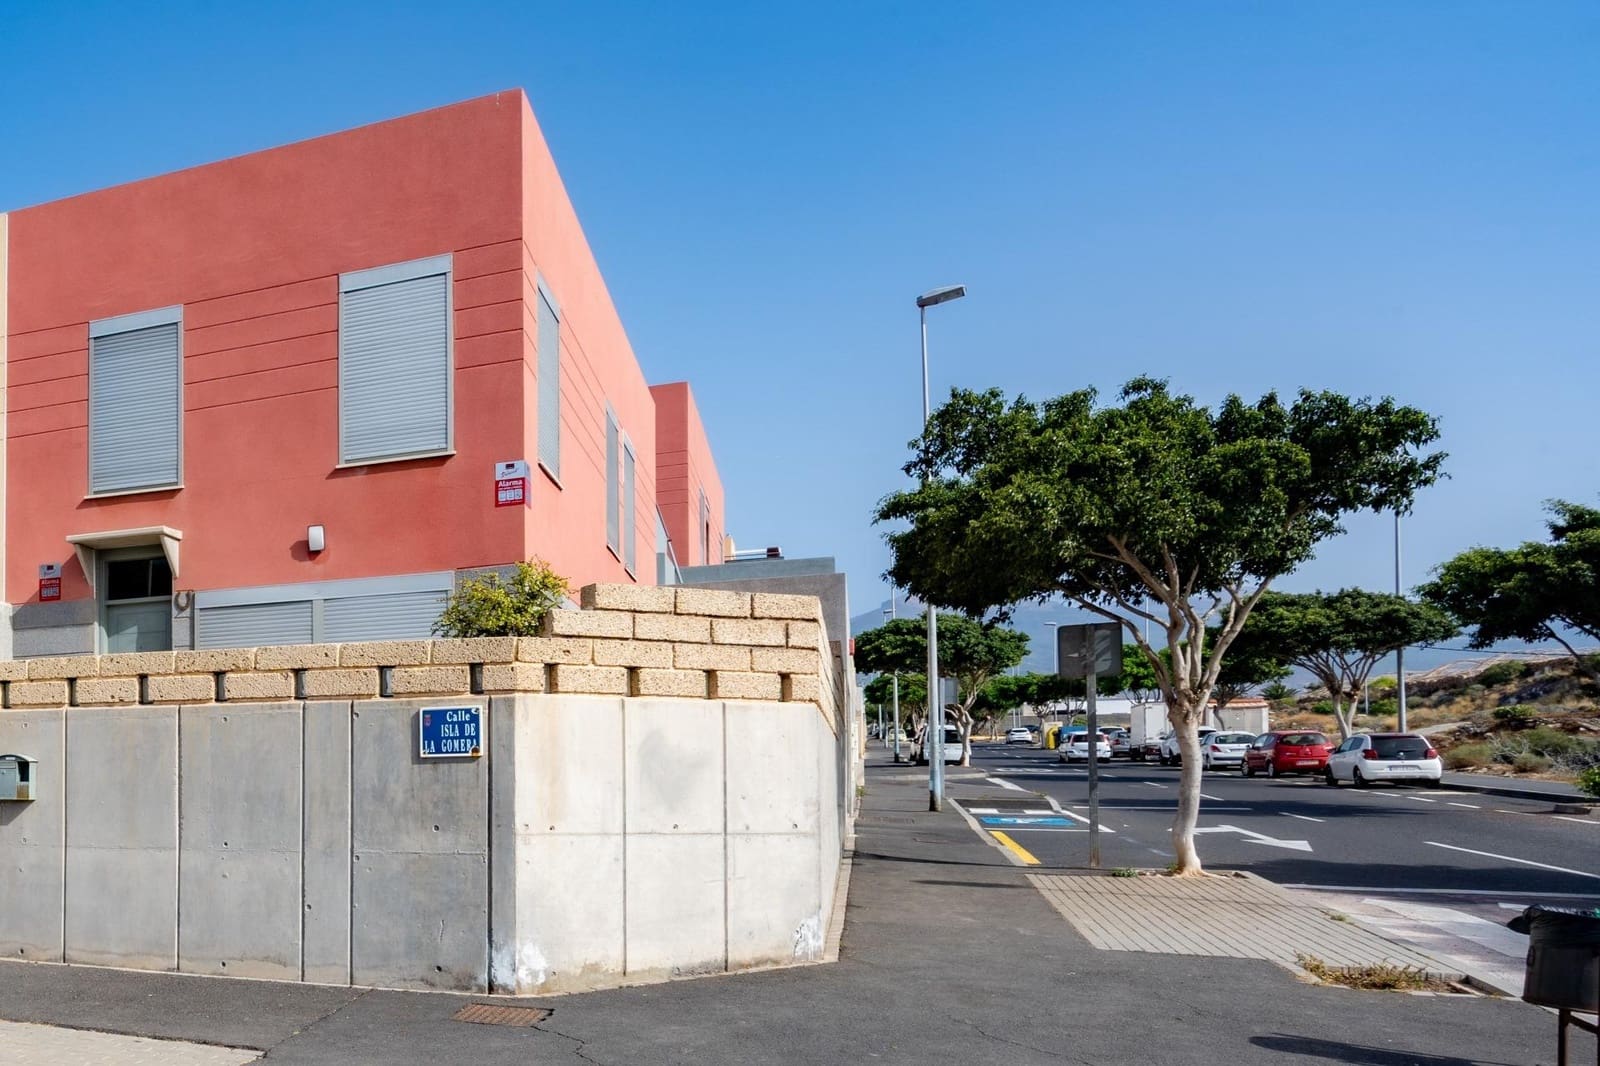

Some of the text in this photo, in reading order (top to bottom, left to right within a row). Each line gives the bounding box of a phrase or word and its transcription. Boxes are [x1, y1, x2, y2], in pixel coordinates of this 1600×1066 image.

[498, 479, 523, 488] Alarma
[446, 710, 471, 722] Calle
[440, 722, 476, 737] ISLA DE
[424, 740, 436, 753] LA
